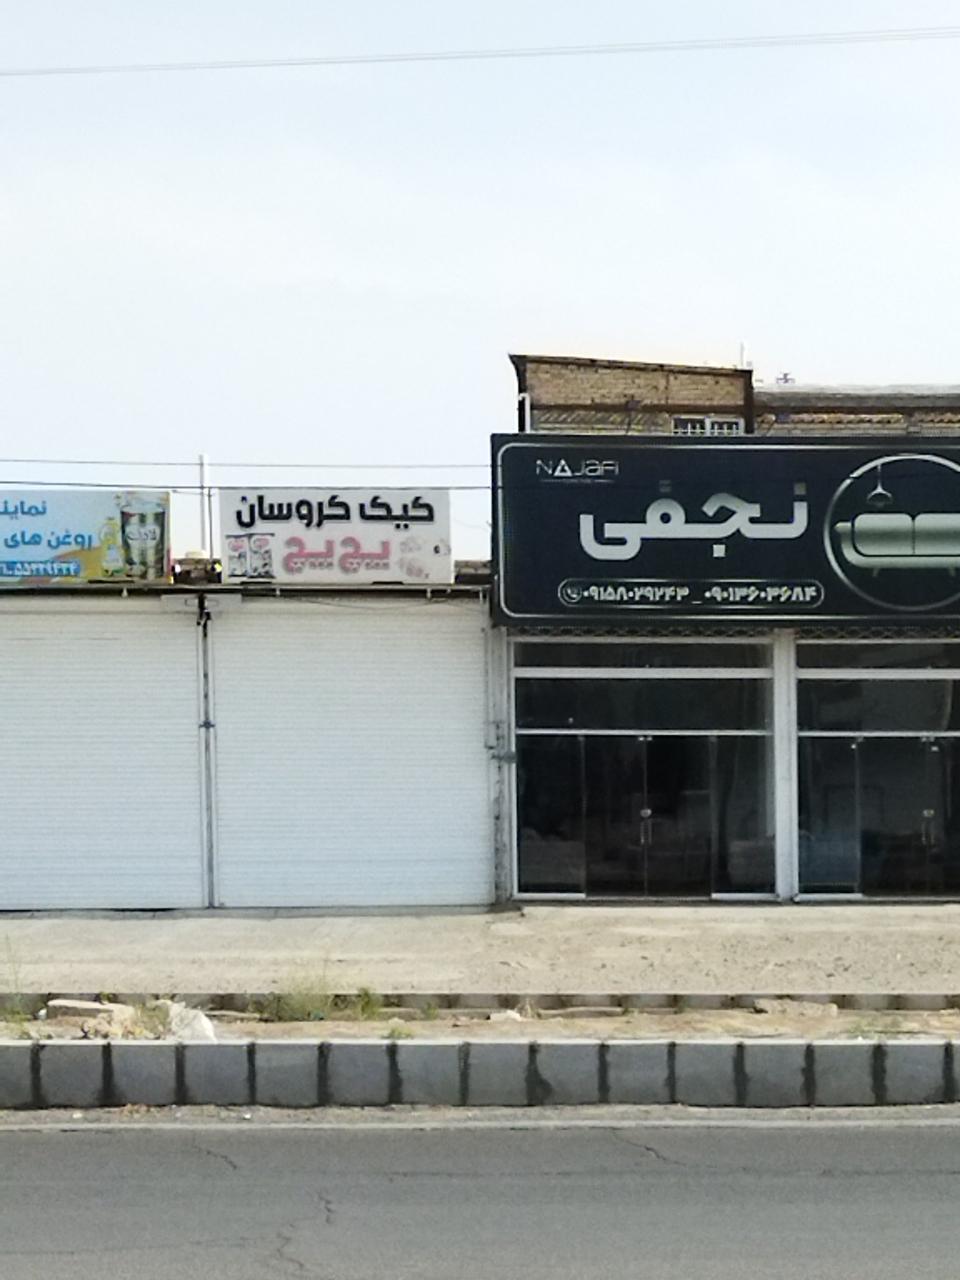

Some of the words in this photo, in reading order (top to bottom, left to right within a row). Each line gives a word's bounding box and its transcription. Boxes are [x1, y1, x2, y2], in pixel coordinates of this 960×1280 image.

[236, 495, 350, 528] کروسان
[359, 495, 434, 529] کیک
[580, 481, 809, 561] نجفی
[4, 530, 42, 549] های
[47, 528, 93, 550] روغن
